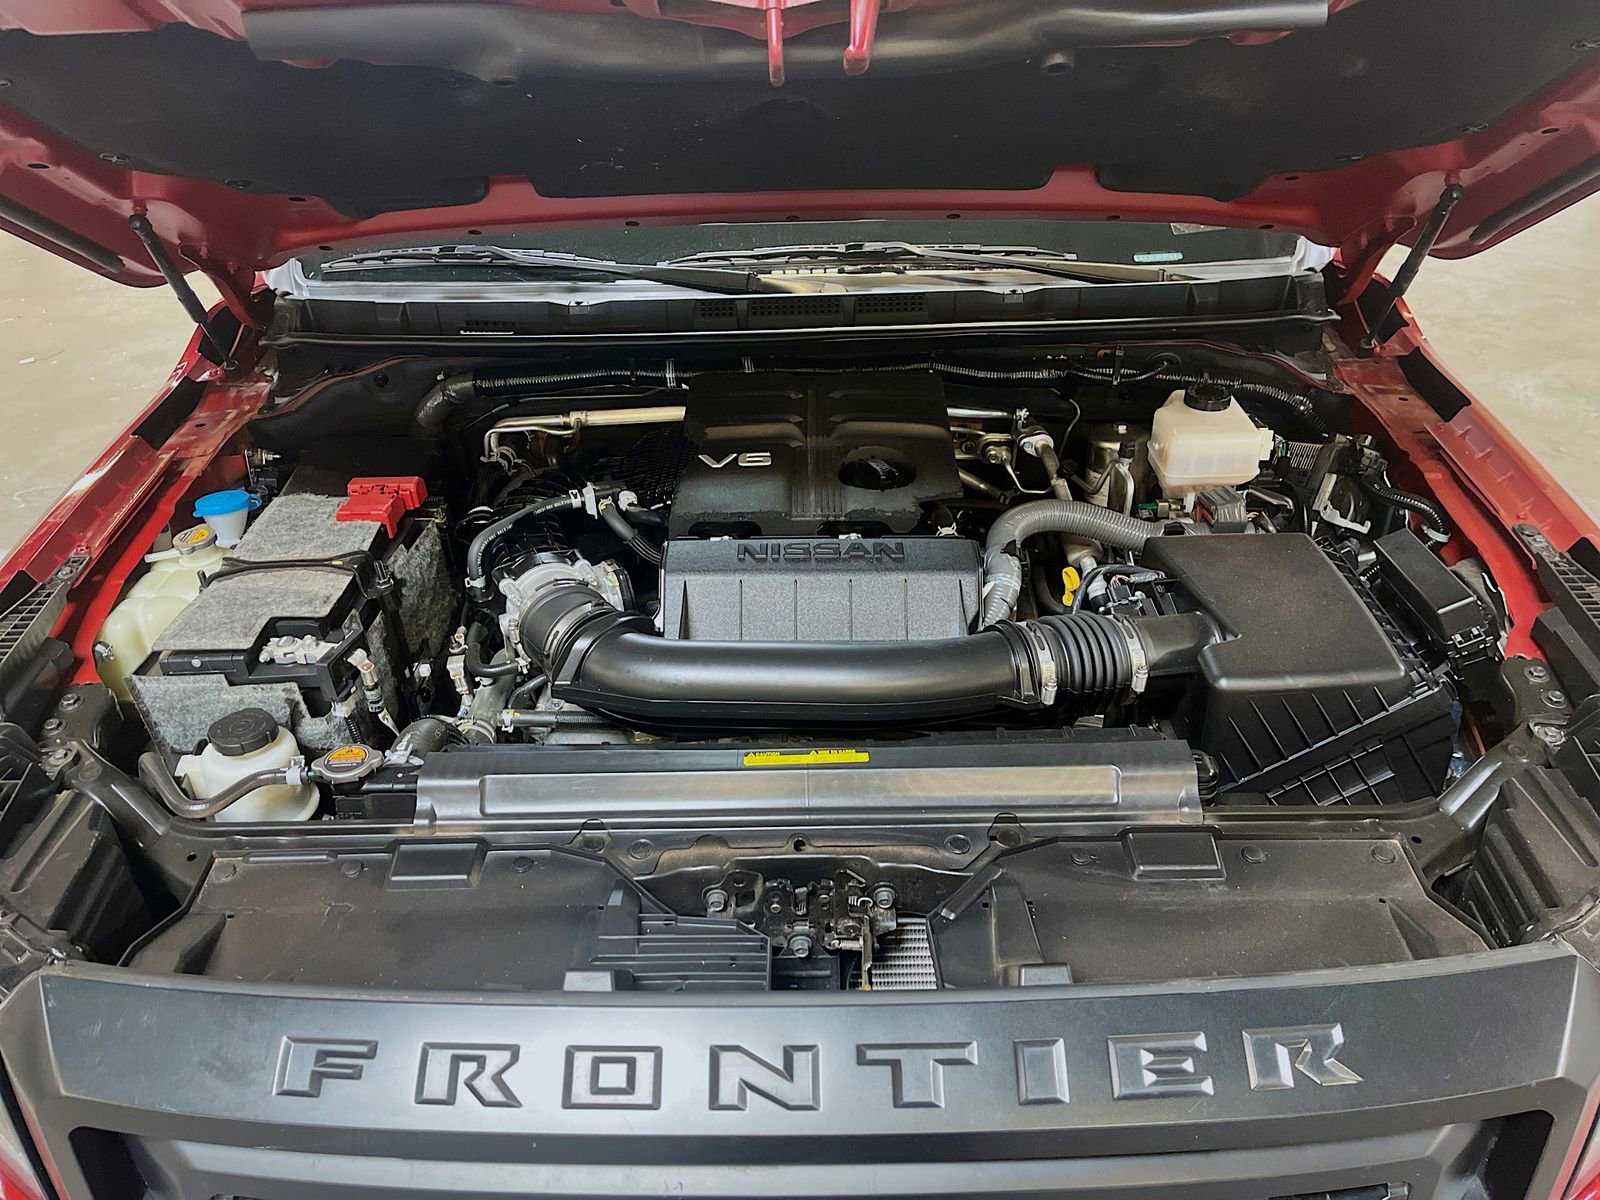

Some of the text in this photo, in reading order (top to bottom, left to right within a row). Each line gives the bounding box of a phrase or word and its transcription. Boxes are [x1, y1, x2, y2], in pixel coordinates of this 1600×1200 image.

[697, 451, 773, 469] V6
[736, 541, 905, 563] NISSAN
[272, 1022, 1364, 1111] FRONTIER
